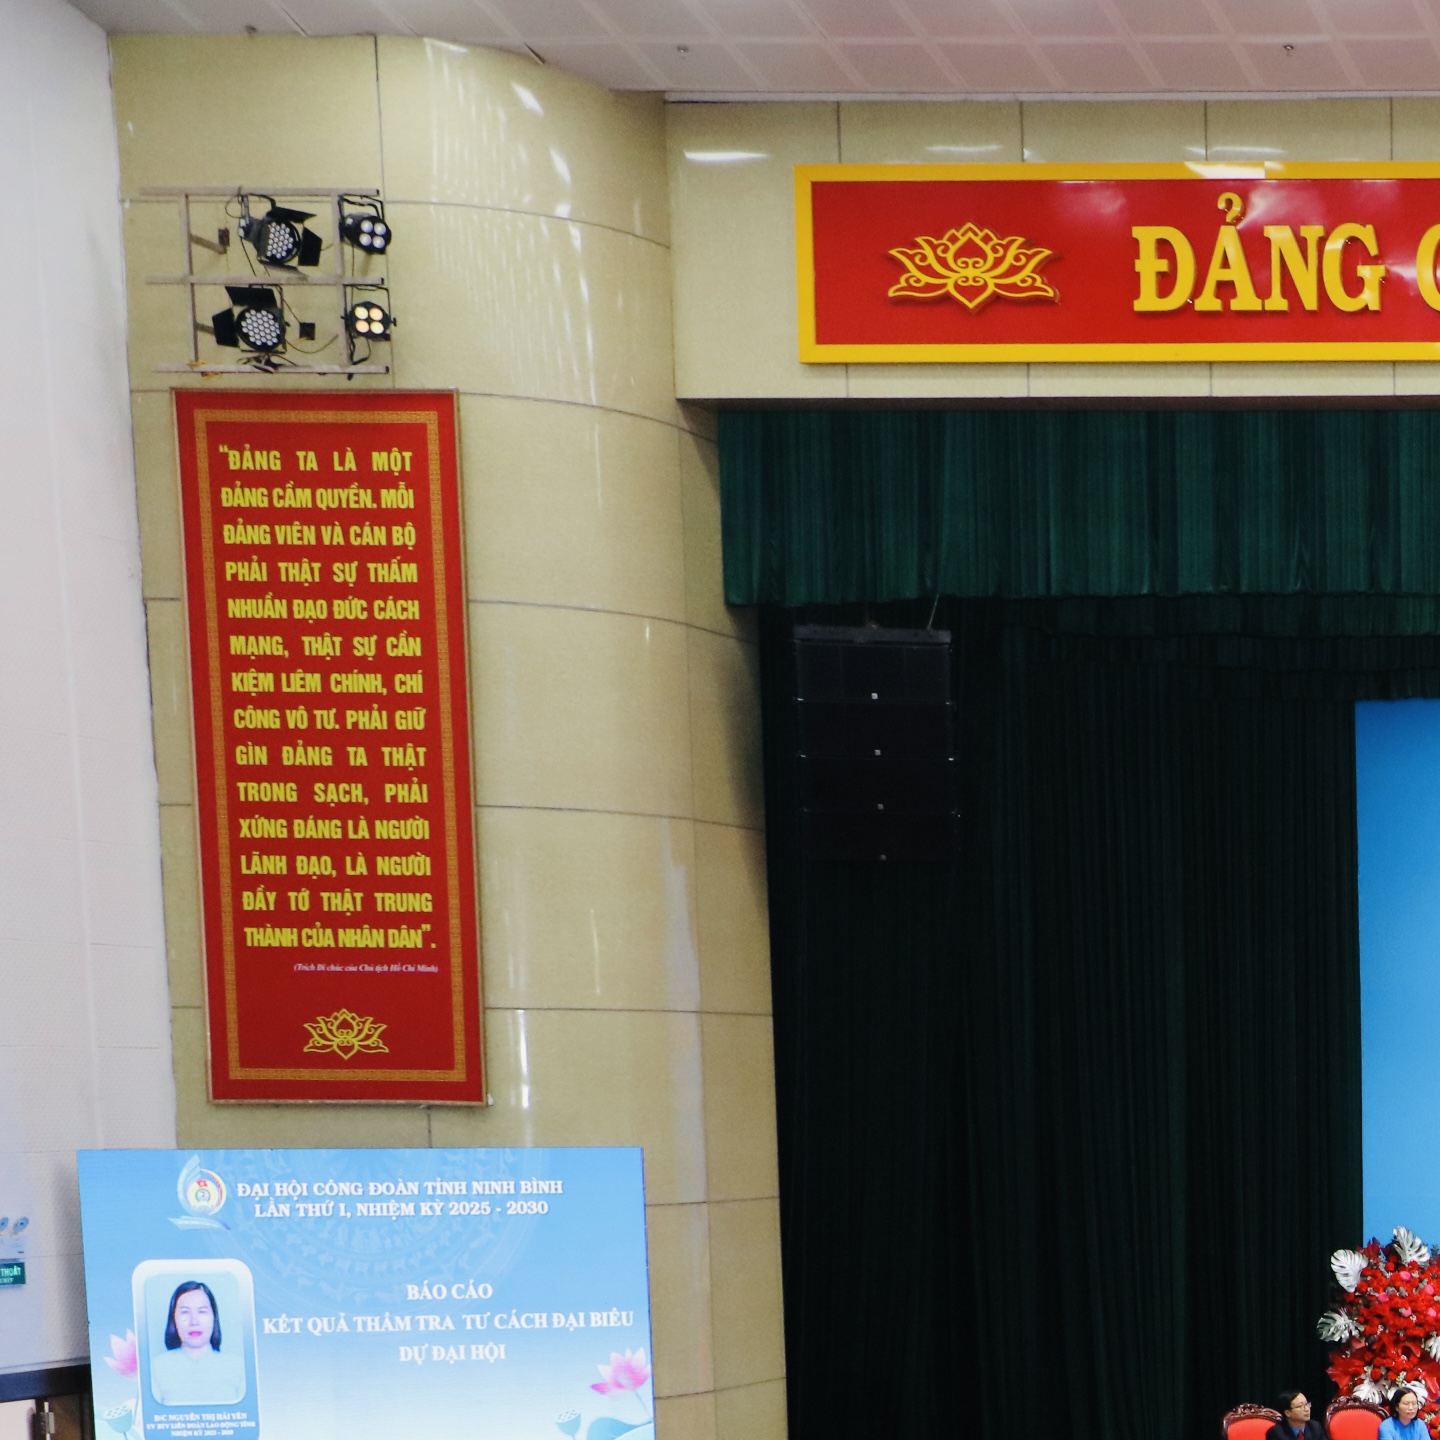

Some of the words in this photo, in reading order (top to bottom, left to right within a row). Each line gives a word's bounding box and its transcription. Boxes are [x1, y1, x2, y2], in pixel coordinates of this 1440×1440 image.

[1131, 192, 1387, 314] ĐẢNG
[296, 451, 318, 471] TA
[333, 447, 357, 471] LÀ
[372, 447, 412, 476] MỘT
[221, 481, 268, 508] ĐẢNG
[272, 480, 312, 508] CẦM
[380, 481, 414, 509] MỖI
[223, 518, 271, 544] ĐẢNG
[275, 521, 316, 545] VIÊN
[321, 521, 345, 546] VÀ
[349, 521, 386, 546] CÁN
[392, 522, 416, 550] BỘ
[225, 555, 268, 582] PHẢI
[278, 558, 321, 586] THẬT
[332, 561, 358, 587] SỰ
[237, 1183, 270, 1200] ĐẠI
[275, 1182, 308, 1201] HỘI
[313, 1181, 363, 1197] CÔNG
[368, 1179, 419, 1196] ĐOÀN
[423, 1177, 467, 1196] TỈNH
[472, 1181, 515, 1195] NINH
[520, 1178, 563, 1195] BÌNH
[295, 1199, 334, 1217] THỨ
[356, 1199, 415, 1221] NHIỆM
[420, 1198, 444, 1216] KỲ
[450, 1201, 491, 1216] 2025
[507, 1201, 549, 1215] 2030
[406, 1283, 447, 1301] BÁO
[451, 1280, 493, 1300] CÁO
[415, 1315, 455, 1331] TRA
[462, 1312, 491, 1330] TƯ
[493, 1310, 548, 1329] CÁCH
[552, 1312, 586, 1332] ĐẠI
[400, 1345, 429, 1365] DỰ
[432, 1345, 466, 1365] ĐẠI
[470, 1342, 506, 1364] HỘI
